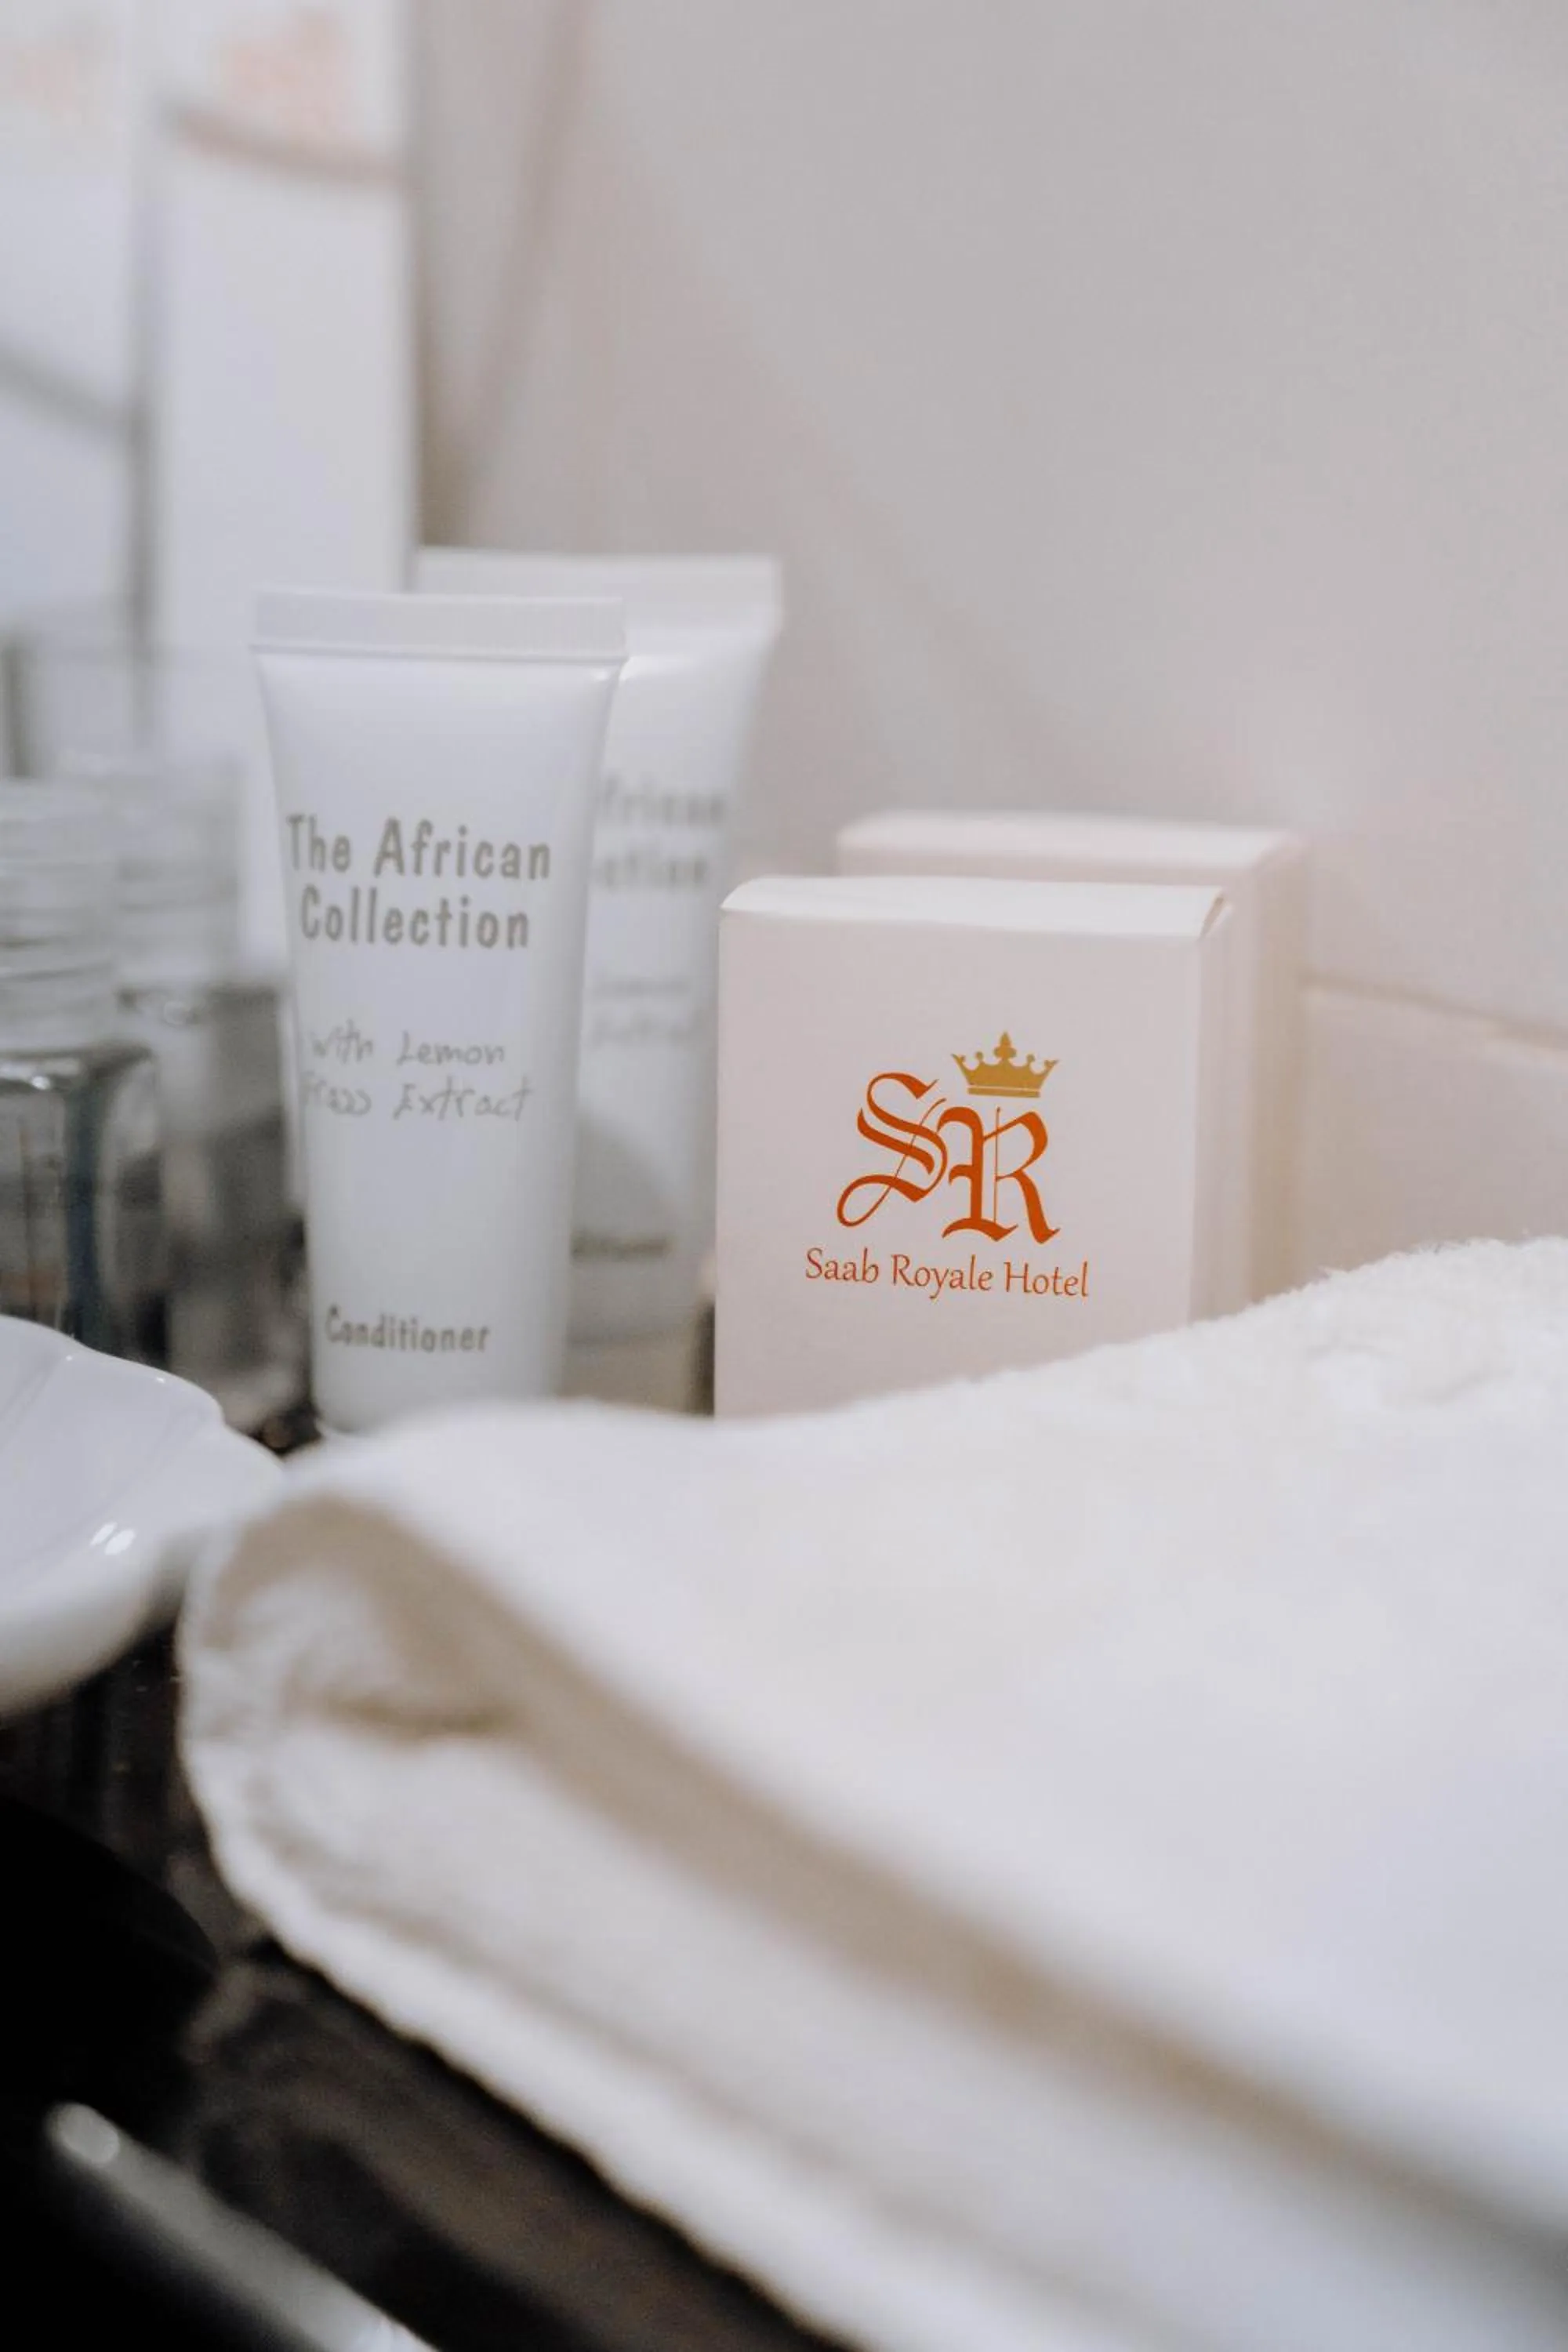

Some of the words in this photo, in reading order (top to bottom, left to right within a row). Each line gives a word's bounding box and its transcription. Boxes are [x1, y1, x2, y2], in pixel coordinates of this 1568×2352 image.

[286, 812, 351, 873] The
[373, 816, 551, 881] African
[300, 884, 530, 949] Collection
[396, 1029, 506, 1066] Lemon
[393, 1073, 535, 1121] Extract
[805, 1247, 880, 1284] Saab
[891, 1254, 994, 1300] Royale
[1004, 1261, 1090, 1298] Hotel
[325, 1305, 492, 1352] Conditioner
